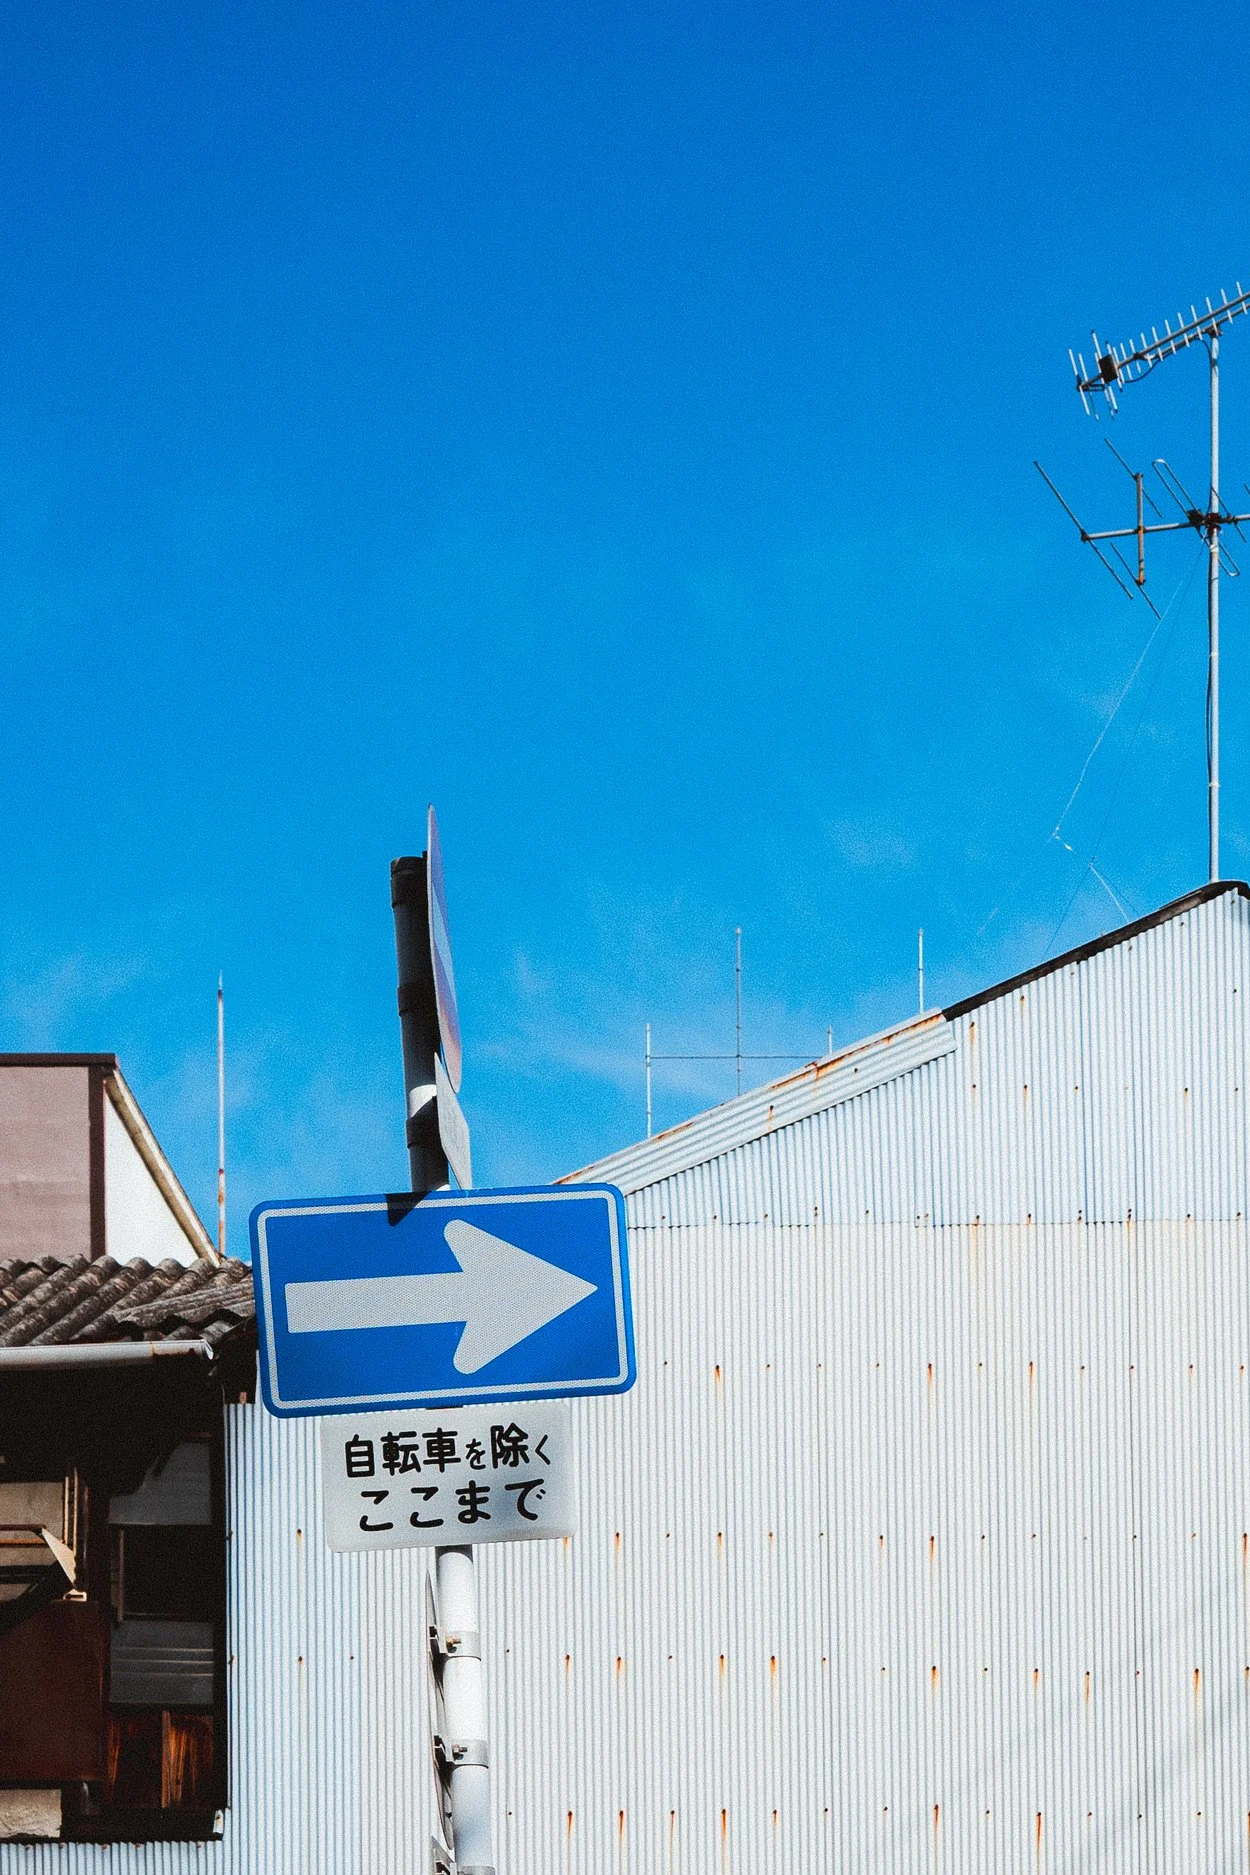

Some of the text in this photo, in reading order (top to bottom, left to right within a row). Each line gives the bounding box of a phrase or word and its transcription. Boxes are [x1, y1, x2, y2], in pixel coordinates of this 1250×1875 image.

[344, 1422, 551, 1478] 自転車を除く
[358, 1478, 548, 1533] ここまで
